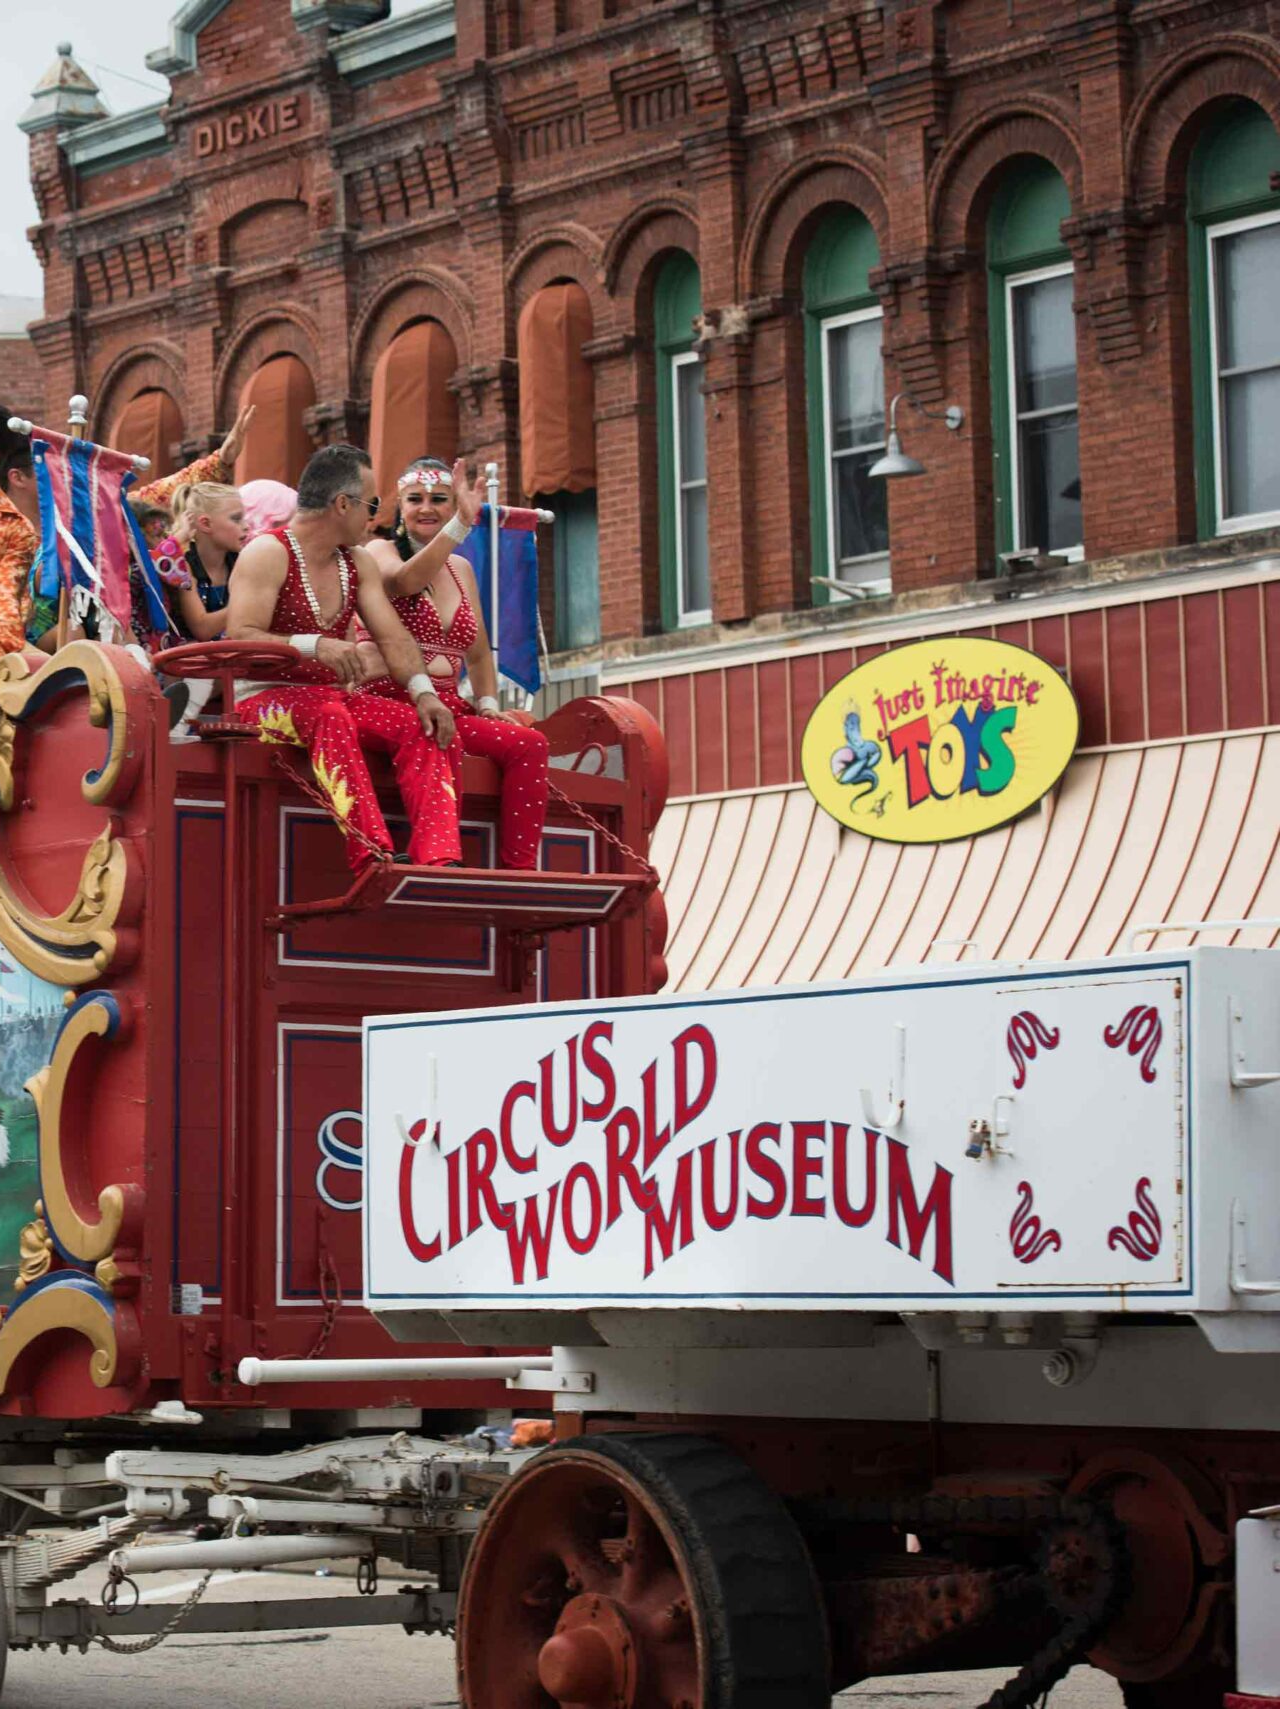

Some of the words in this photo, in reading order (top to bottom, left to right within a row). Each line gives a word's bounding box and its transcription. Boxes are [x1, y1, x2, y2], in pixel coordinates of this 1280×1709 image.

[194, 96, 300, 158] DICKIE
[929, 659, 1045, 712] Imagine
[886, 704, 1018, 810] TOYS
[398, 1020, 617, 1263] CIRCUS
[500, 1022, 719, 1286] WORLD
[642, 1119, 956, 1288] MUSEUM
